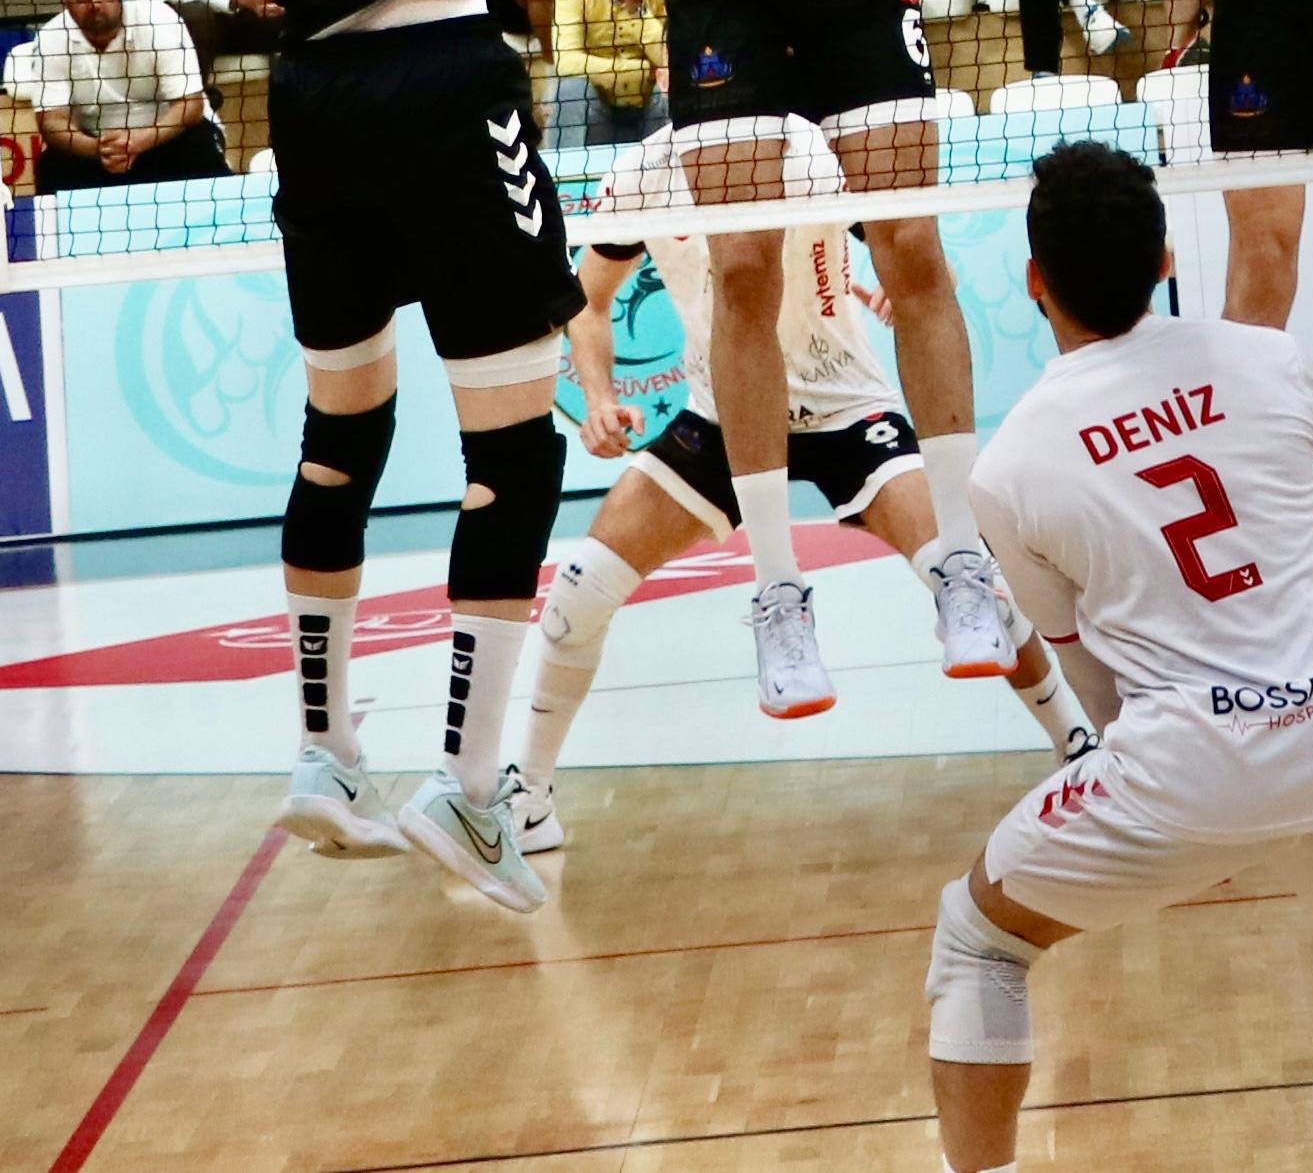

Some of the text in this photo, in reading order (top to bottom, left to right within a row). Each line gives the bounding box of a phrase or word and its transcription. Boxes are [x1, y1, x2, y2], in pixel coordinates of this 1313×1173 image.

[901, 9, 928, 67] 6
[812, 240, 836, 317] Aytemiz
[1078, 383, 1226, 466] DENİZ
[1134, 454, 1264, 603] 2
